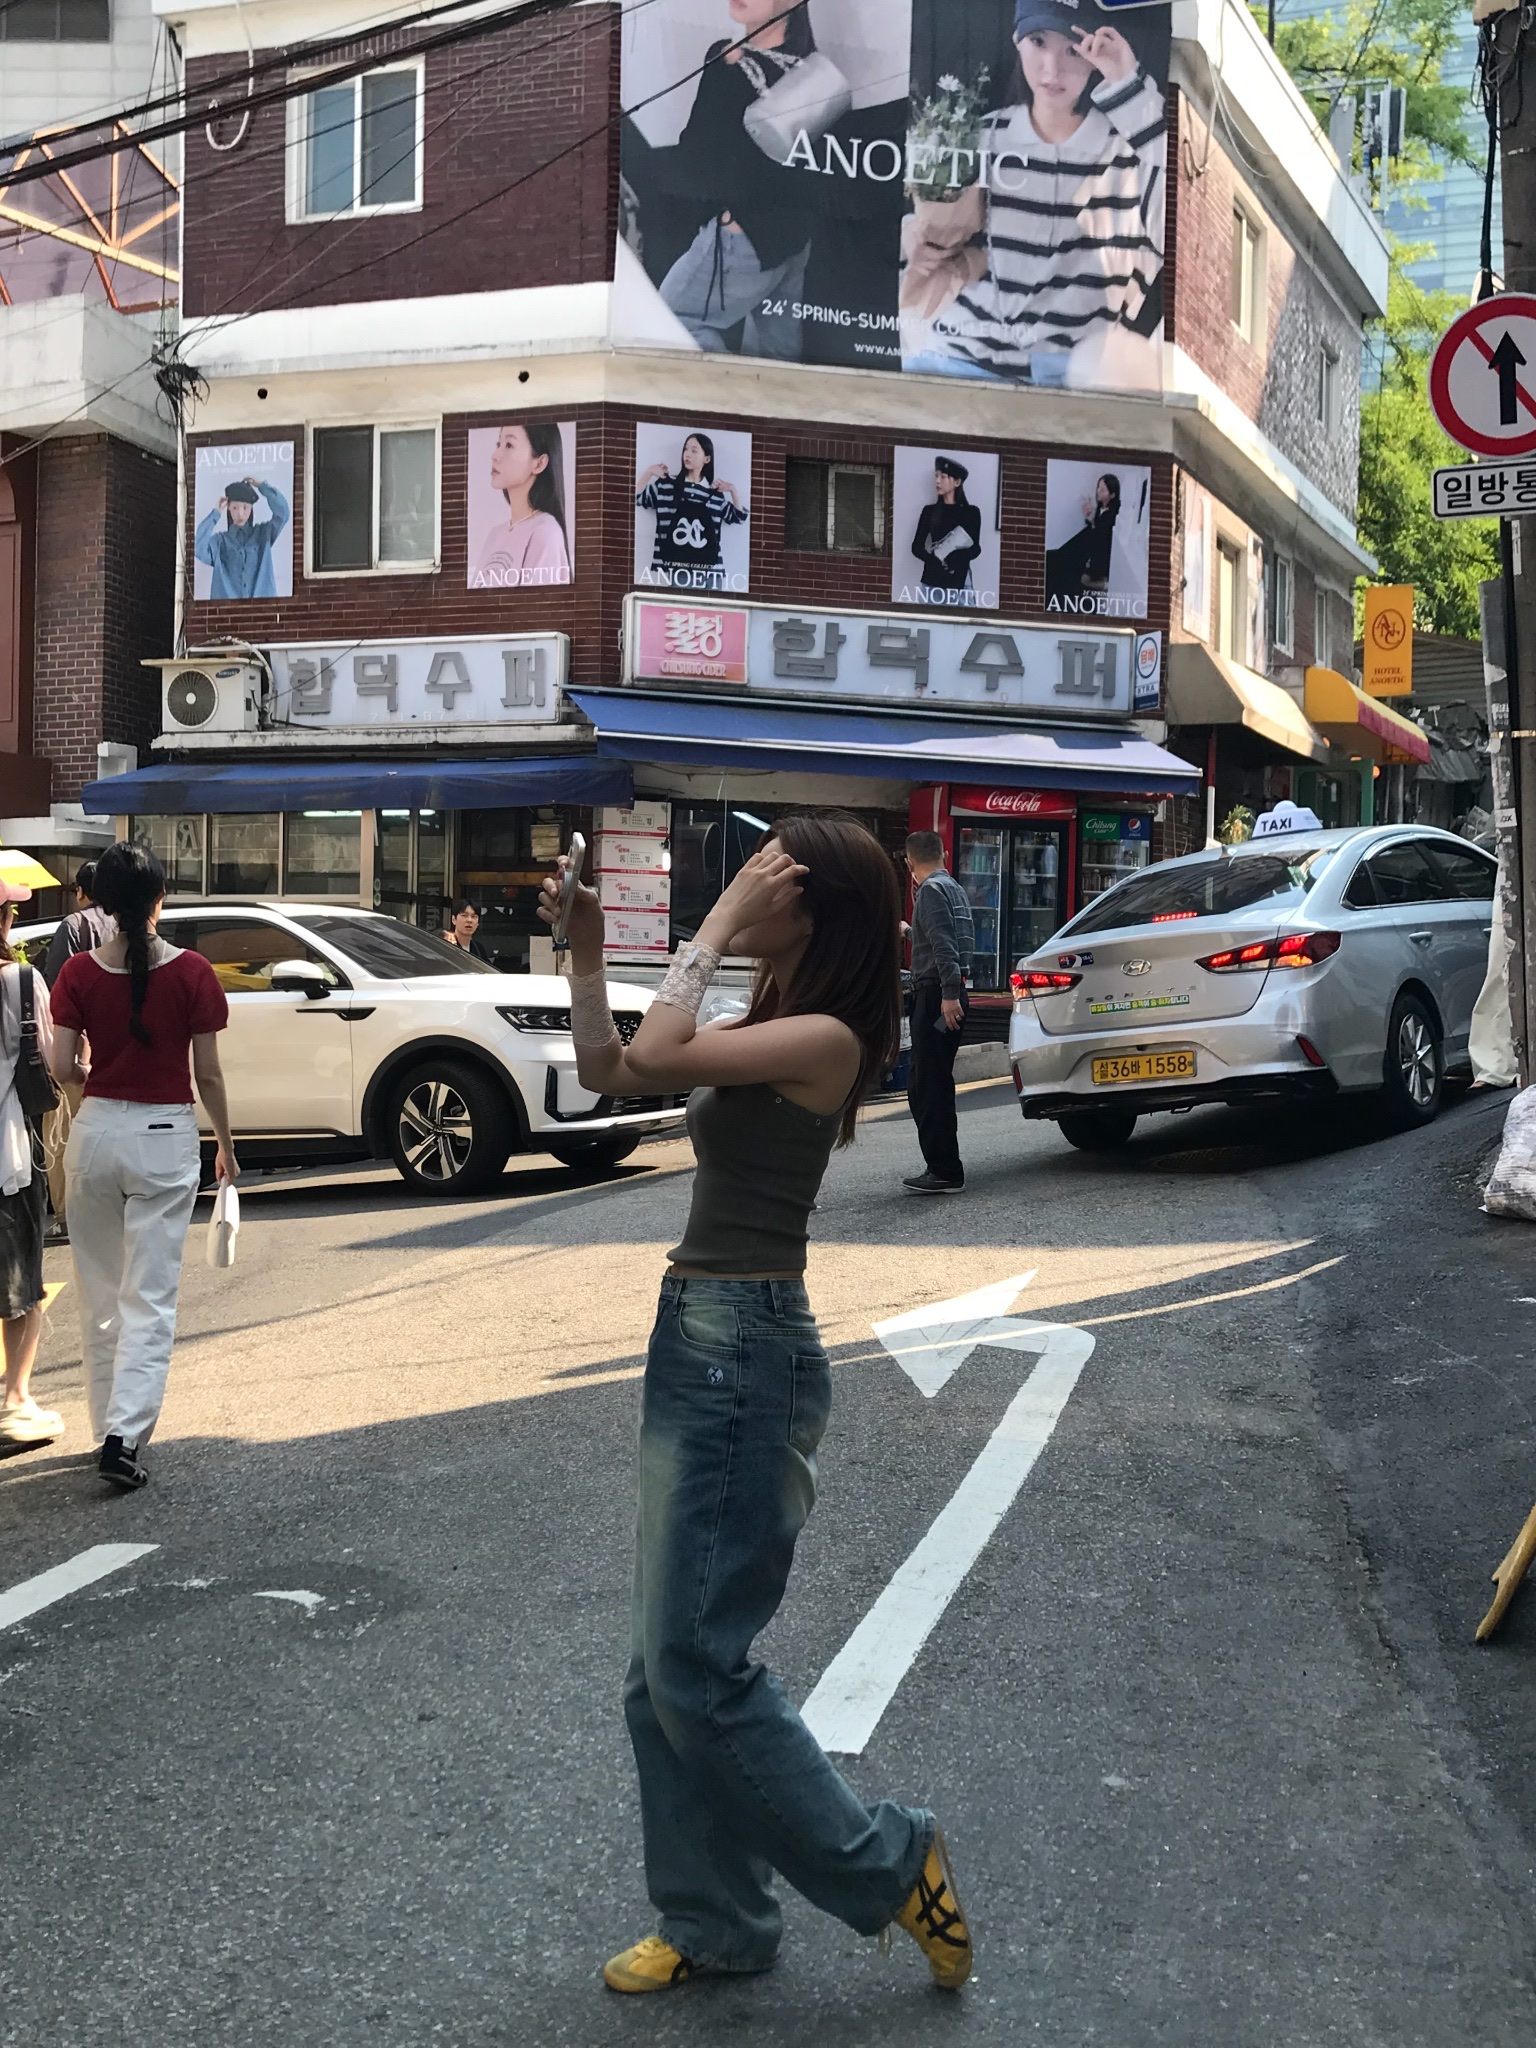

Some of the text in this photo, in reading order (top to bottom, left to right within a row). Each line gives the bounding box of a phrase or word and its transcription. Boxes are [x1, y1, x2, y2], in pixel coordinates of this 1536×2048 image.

[781, 128, 1030, 192] ANOETIC
[762, 299, 788, 317] 24'
[198, 442, 294, 467] ANOETIC
[473, 565, 571, 588] ANOETIC
[639, 566, 747, 592] ANOETIC
[899, 585, 996, 607] ANOETIC
[1046, 593, 1147, 617] ANOETIC
[773, 617, 1117, 699] 합덕수퍼
[1374, 667, 1401, 675] HOTEL
[1261, 817, 1292, 832] TAXI
[1085, 985, 1197, 1003] SONATA
[1111, 1060, 1141, 1078] 36바
[1146, 1055, 1187, 1075] 1558
